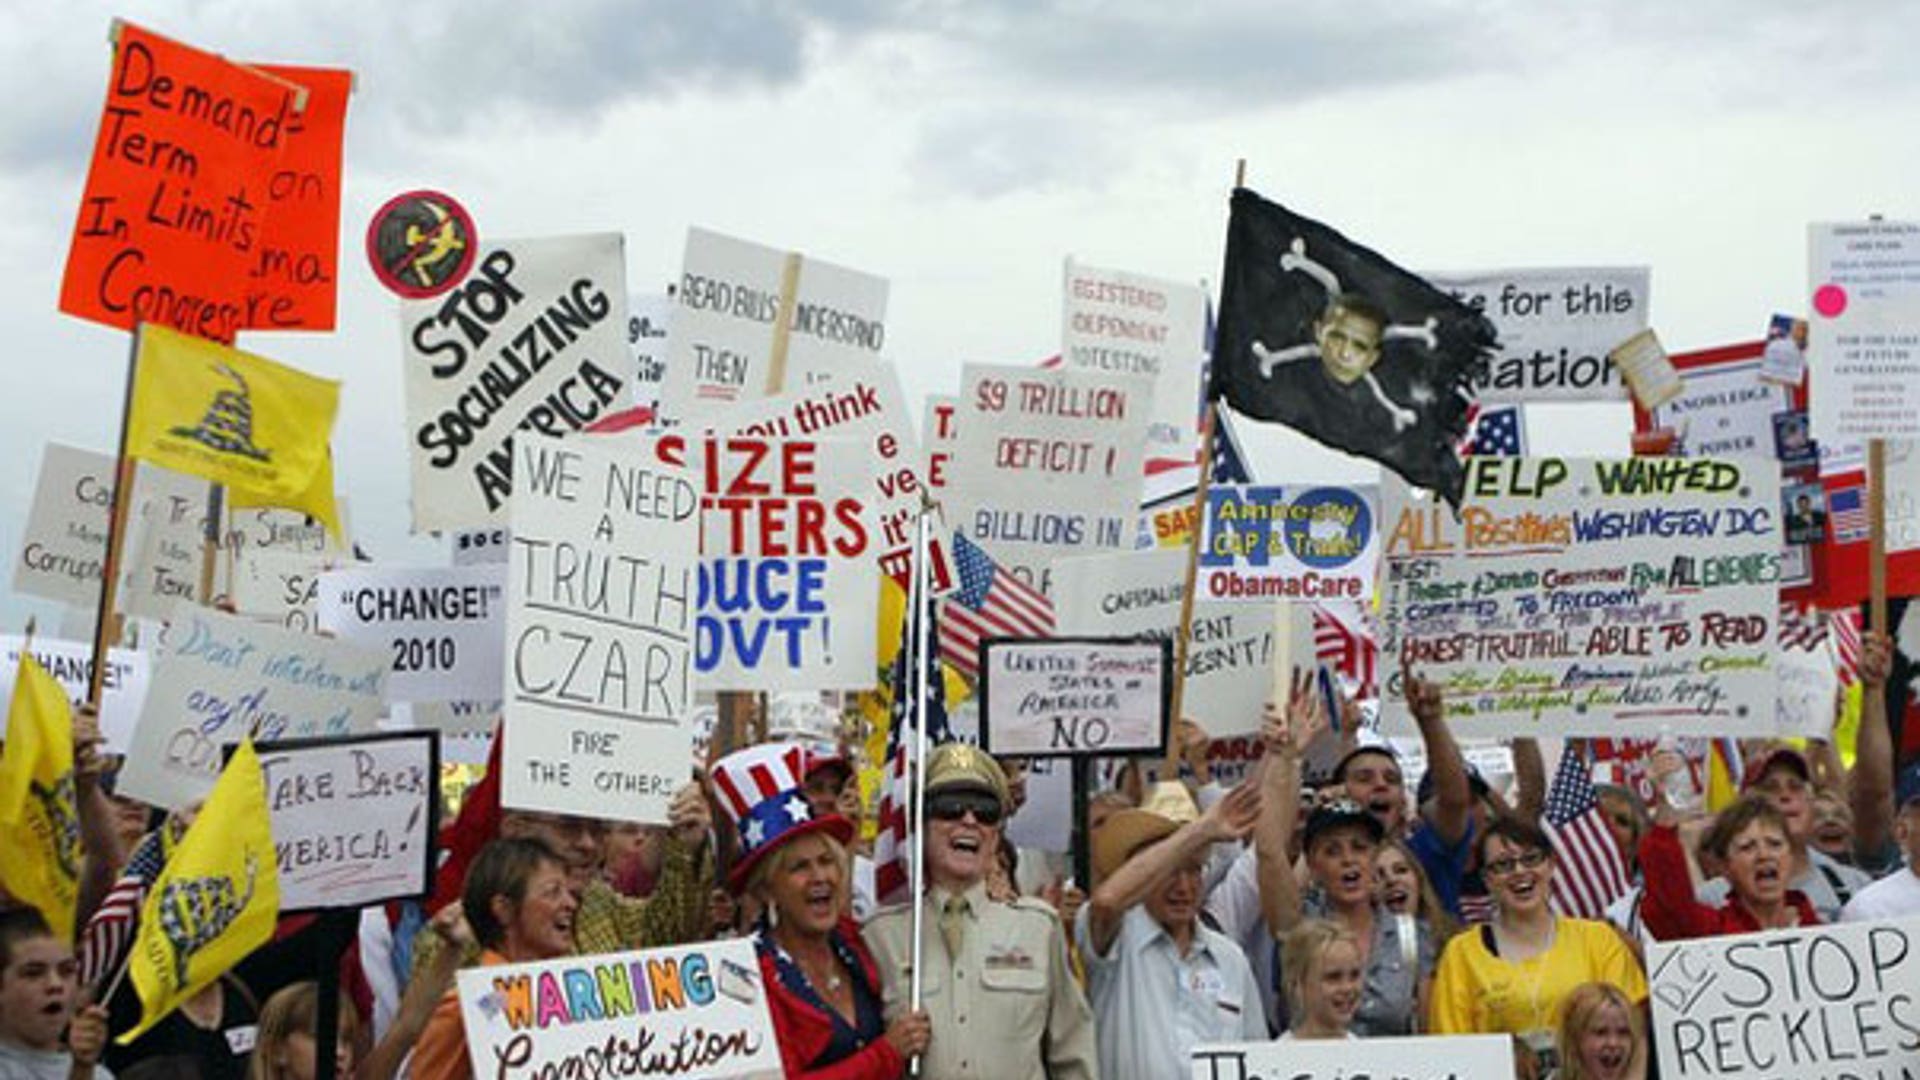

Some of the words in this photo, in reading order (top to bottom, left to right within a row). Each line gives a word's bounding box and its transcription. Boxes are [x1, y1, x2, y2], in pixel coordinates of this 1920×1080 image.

[117, 41, 291, 149] Demand
[105, 107, 198, 177] Term
[81, 197, 128, 240] In
[147, 180, 253, 250] Limits
[680, 272, 732, 311] READ
[1501, 284, 1551, 316] for
[1566, 284, 1633, 315] this
[411, 249, 525, 379] STOP
[416, 278, 611, 469] SOCIALIZING
[693, 343, 750, 386] THEN
[793, 383, 882, 435] think
[976, 379, 1006, 412] $9
[1018, 382, 1128, 420] TRILLION
[996, 437, 1093, 474] DEFICIT
[526, 447, 583, 501] WE
[605, 463, 698, 523] NEED
[595, 513, 614, 542] A
[974, 510, 1086, 546] BILLIONS
[1097, 517, 1123, 547] IN
[1218, 499, 1359, 526] Amnesty
[1386, 503, 1454, 553] ALL
[1725, 508, 1774, 537] DC
[514, 536, 690, 631] TRUTH
[1209, 570, 1363, 597] ObamaCare
[1668, 555, 1702, 588] ALL
[392, 637, 457, 672] 2010
[1585, 625, 1653, 657] ABLE
[1660, 621, 1692, 651] TO
[1700, 610, 1768, 650] READ
[570, 730, 620, 758] FIRE
[1050, 716, 1110, 748] NO
[527, 761, 570, 787] THE
[1722, 927, 1909, 1008] STOP
[494, 952, 716, 1030] WARNING
[494, 1027, 763, 1080] Constitution
